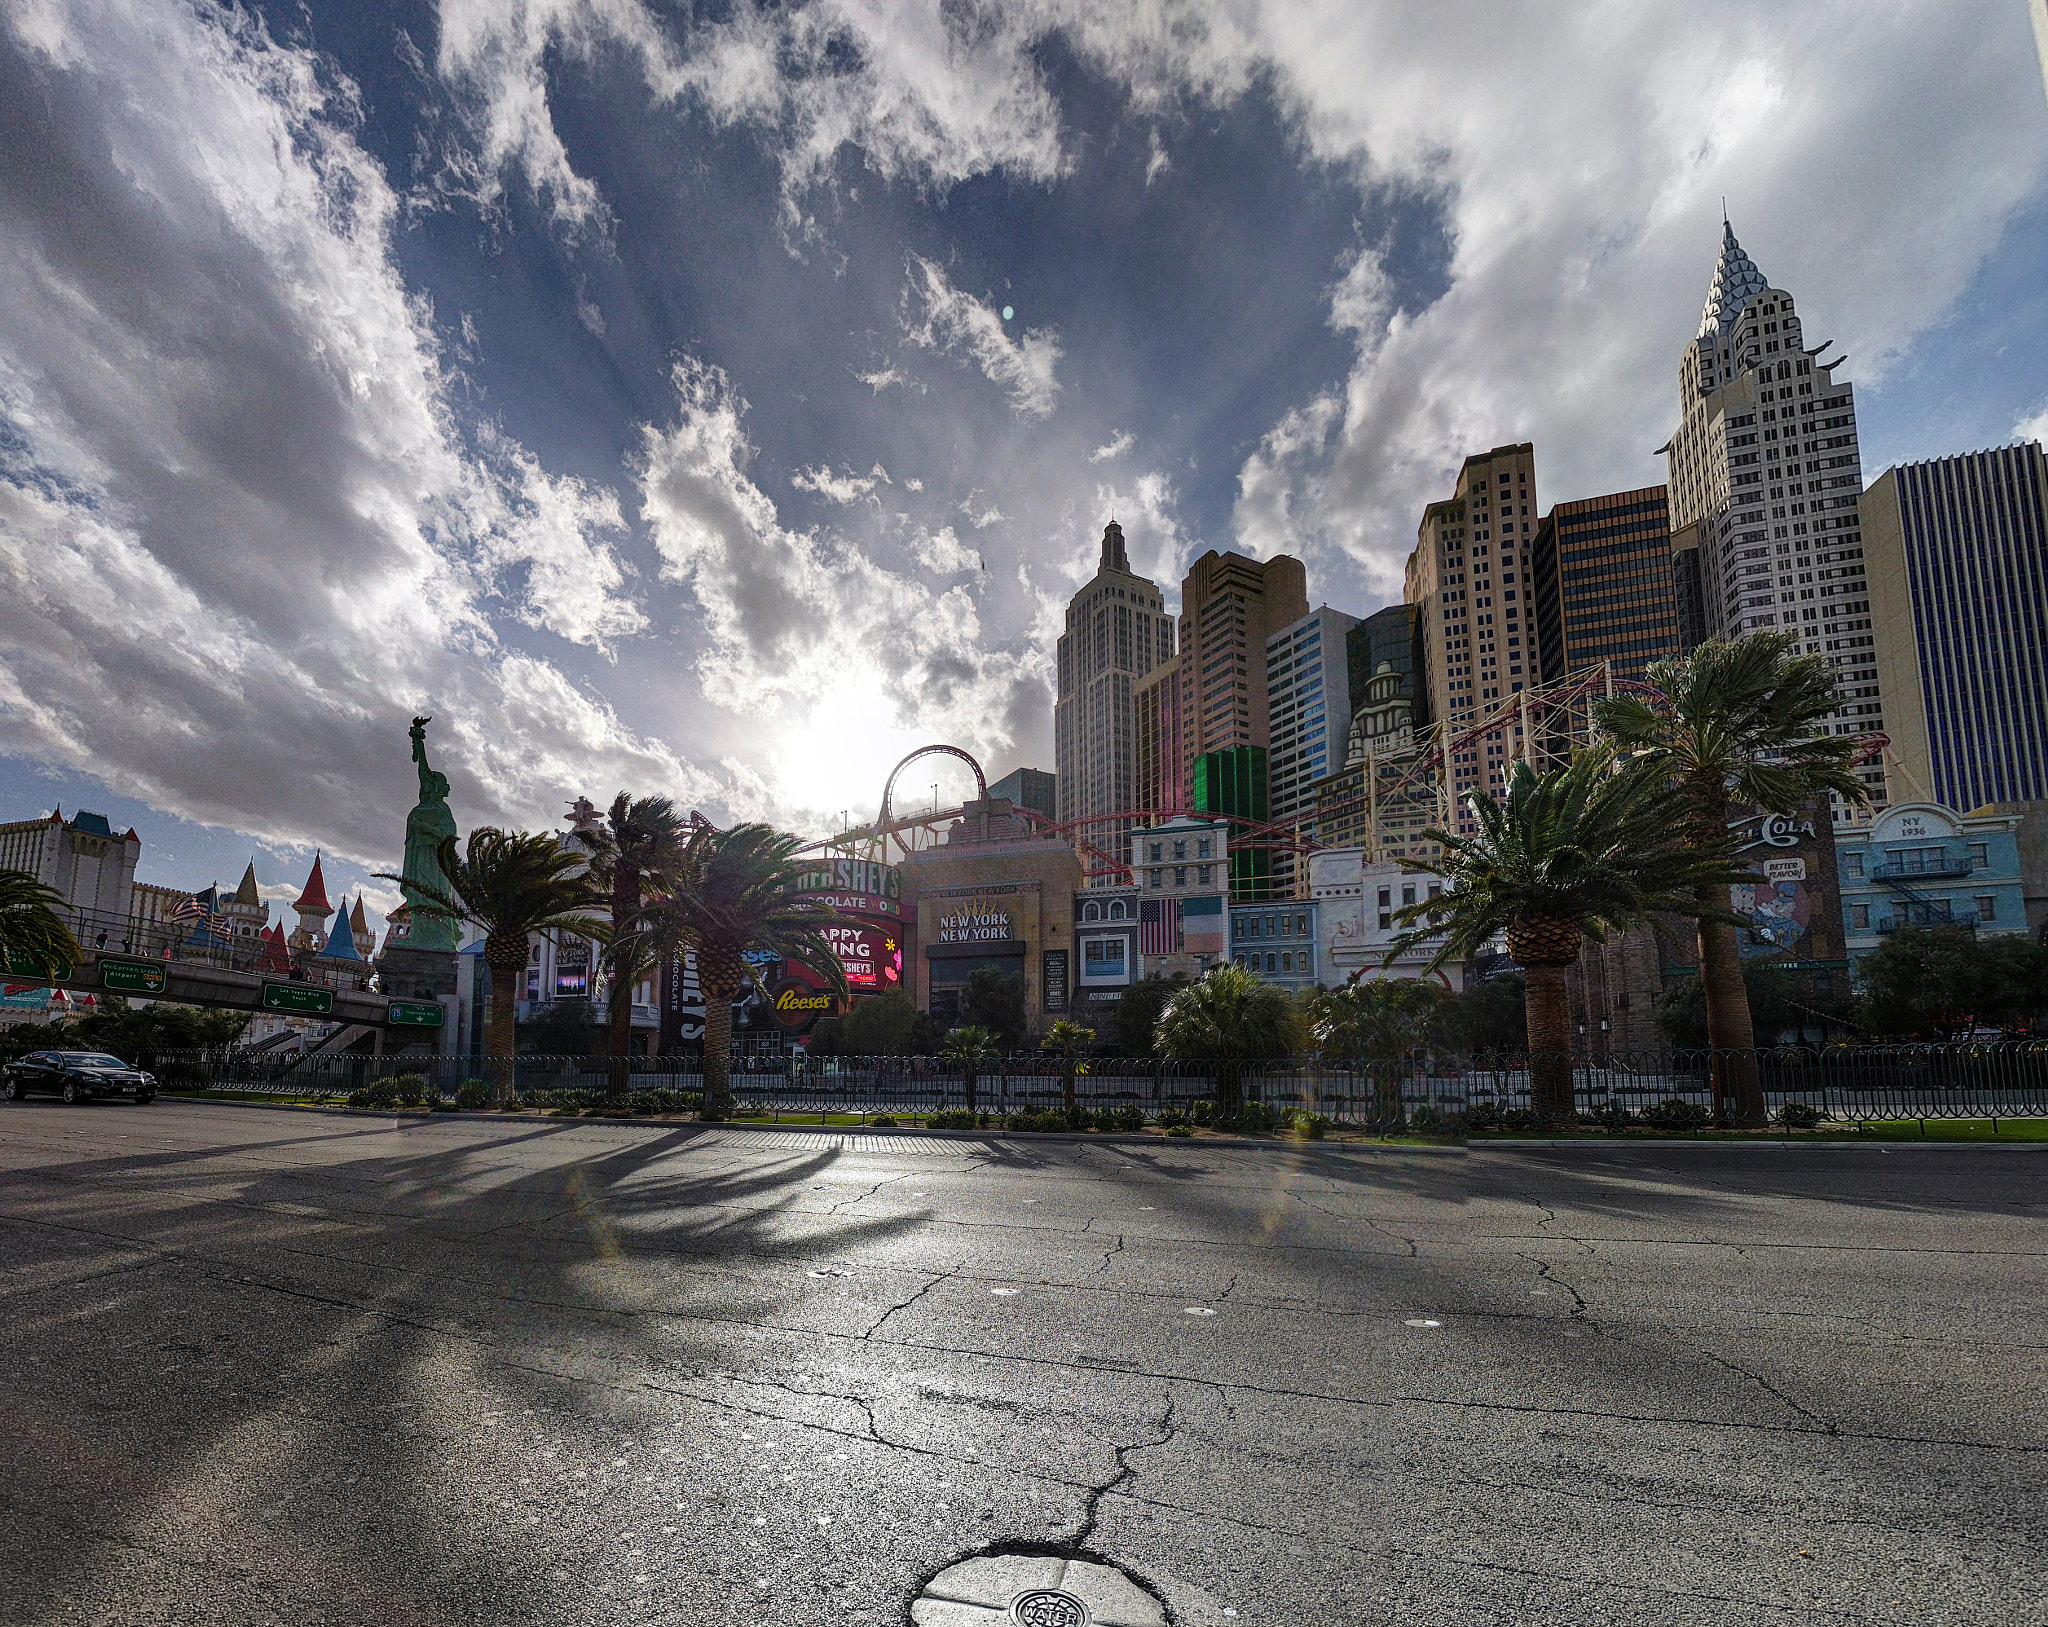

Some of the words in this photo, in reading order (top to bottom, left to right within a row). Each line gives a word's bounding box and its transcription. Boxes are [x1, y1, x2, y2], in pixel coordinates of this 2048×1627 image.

[1902, 817, 1920, 826] NY
[1902, 828, 1925, 836] 1936
[958, 888, 977, 896] YORK
[981, 887, 995, 895] NEW
[996, 885, 1016, 894] YORK
[810, 895, 866, 909] COLATE
[871, 900, 900, 915] WORLD
[941, 916, 969, 928] NEW
[973, 914, 1008, 926] YORK
[820, 929, 863, 941] APPY
[941, 929, 969, 941] NEW
[973, 927, 1008, 940] YORK
[1403, 949, 1435, 957] YORK
[110, 971, 137, 979] Airport
[776, 989, 831, 1010] Reese's
[393, 1008, 402, 1017] 15
[1025, 1606, 1077, 1624] WATER
